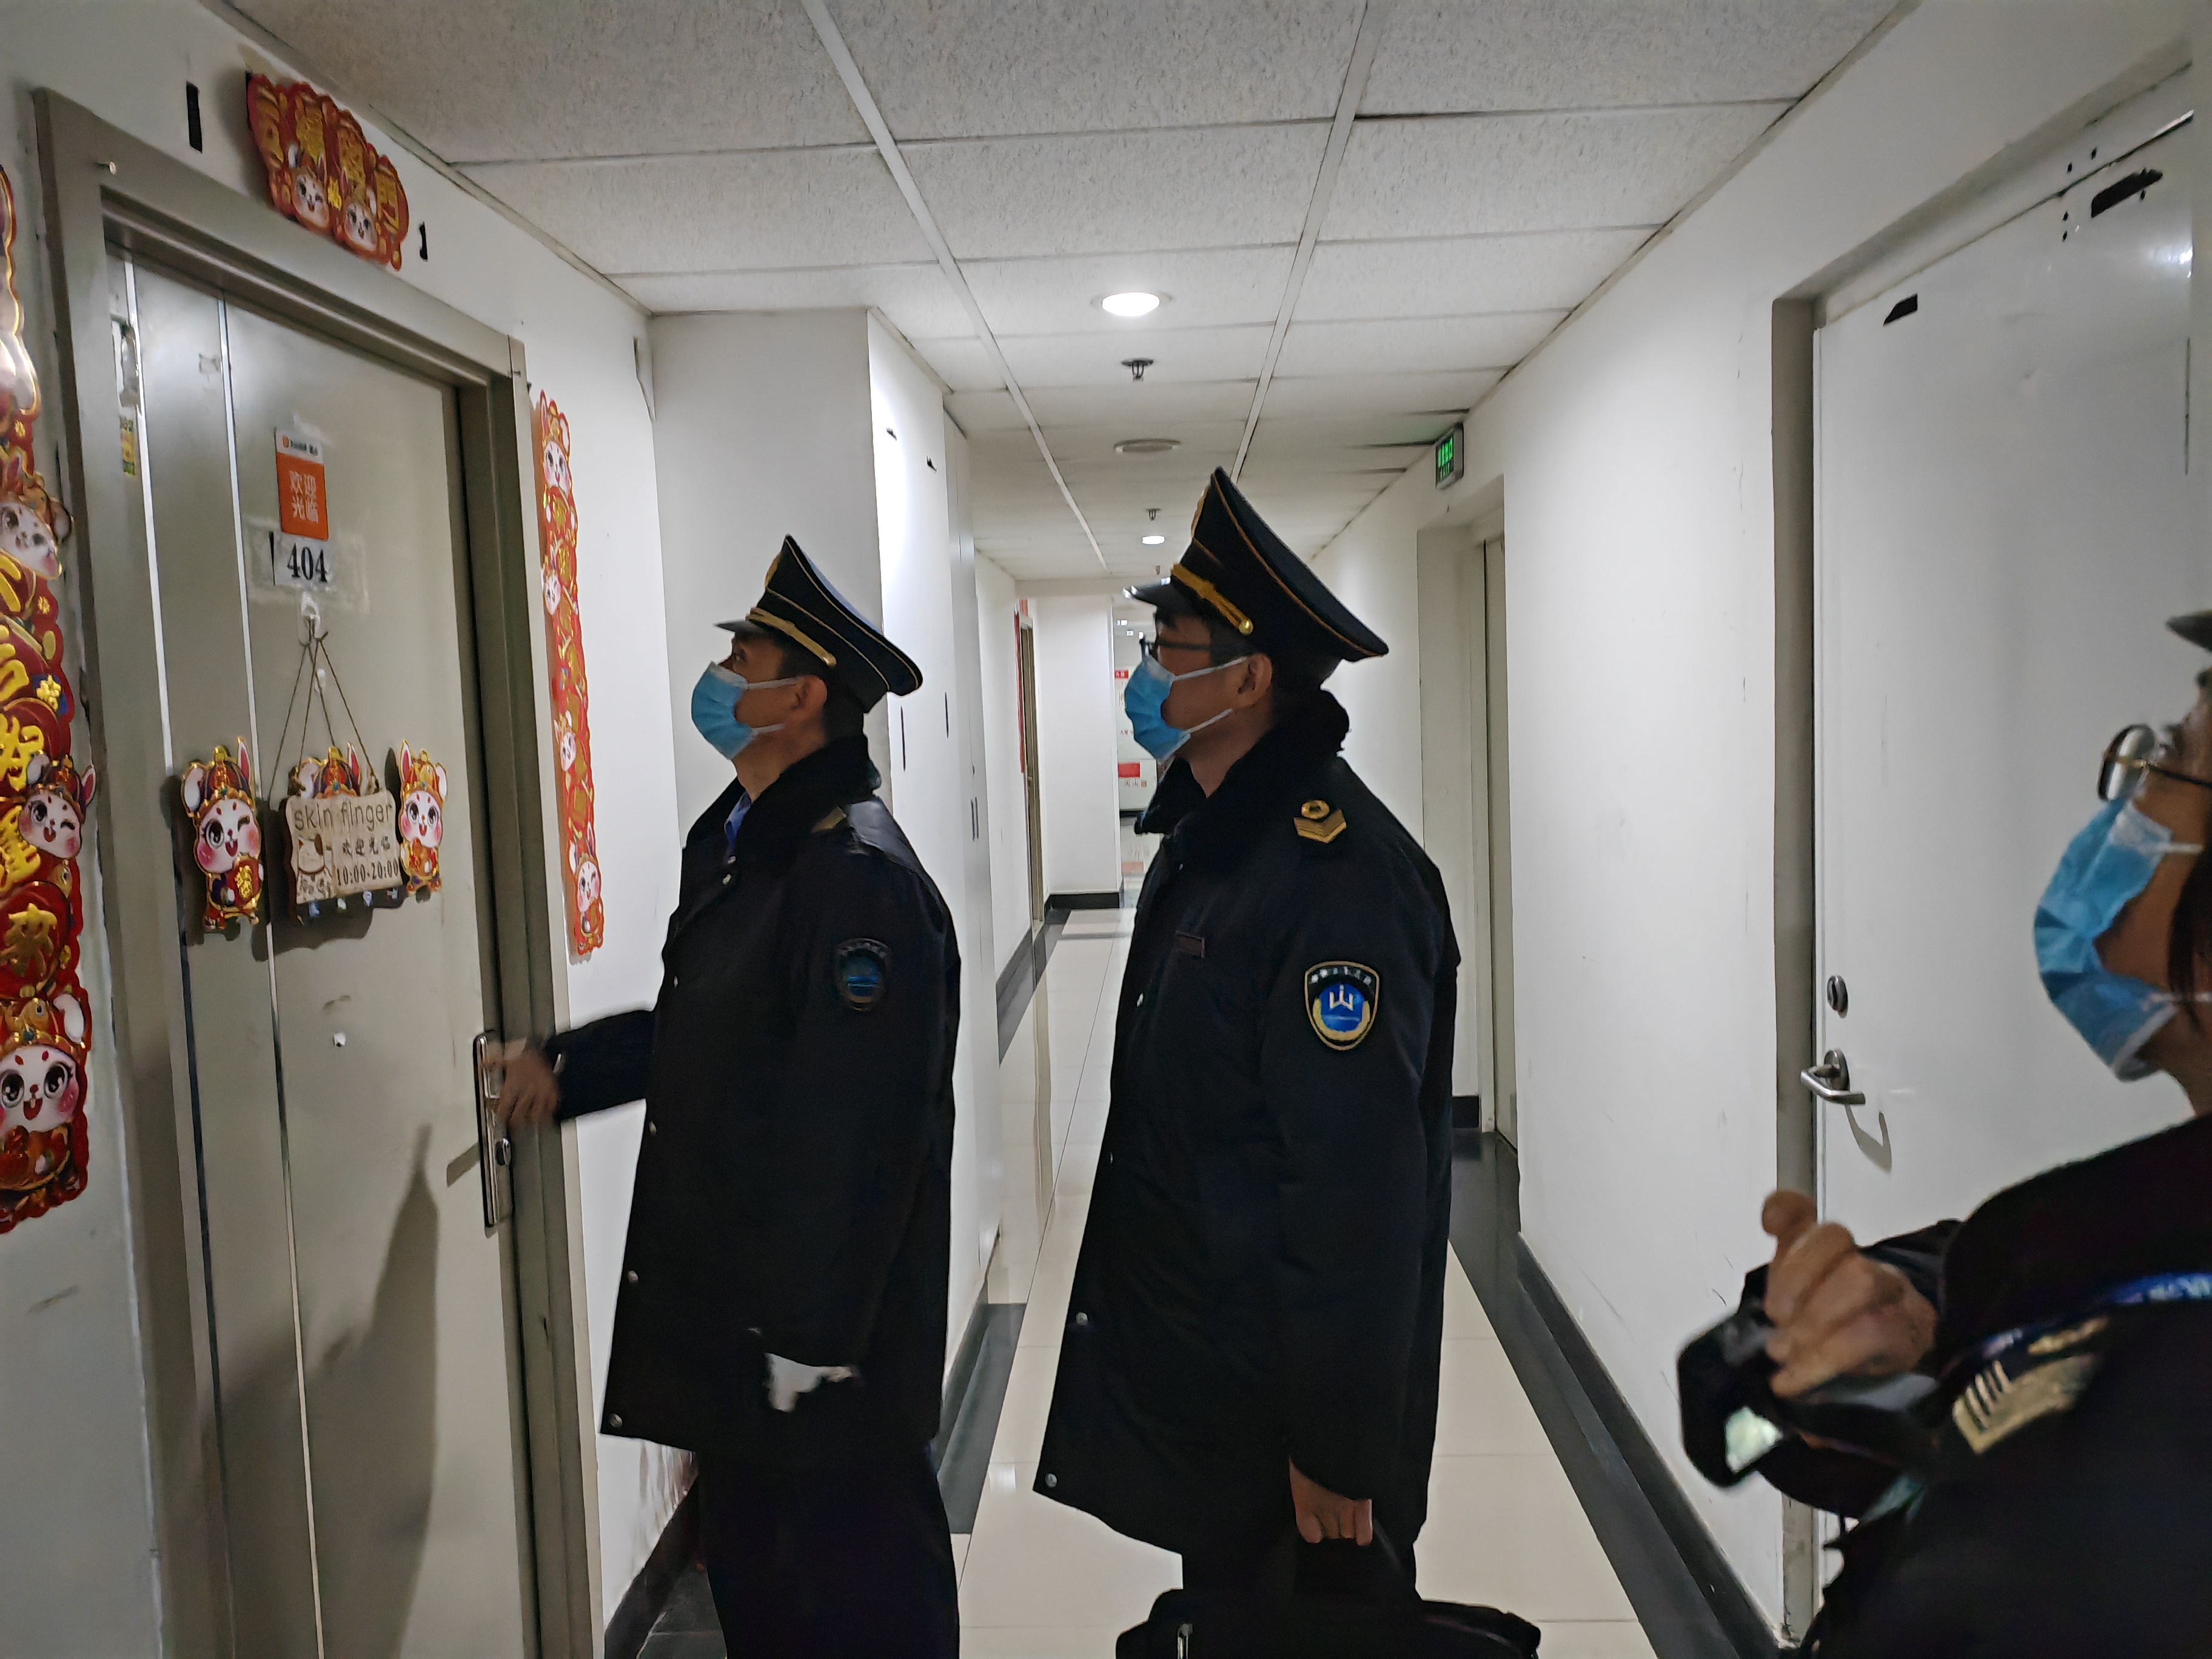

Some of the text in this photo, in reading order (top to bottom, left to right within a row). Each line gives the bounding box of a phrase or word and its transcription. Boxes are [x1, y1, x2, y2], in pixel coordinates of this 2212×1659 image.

[289, 471, 317, 500] 欢迎
[292, 495, 319, 524] 光临
[287, 543, 329, 583] 404
[294, 800, 393, 832] skin finger
